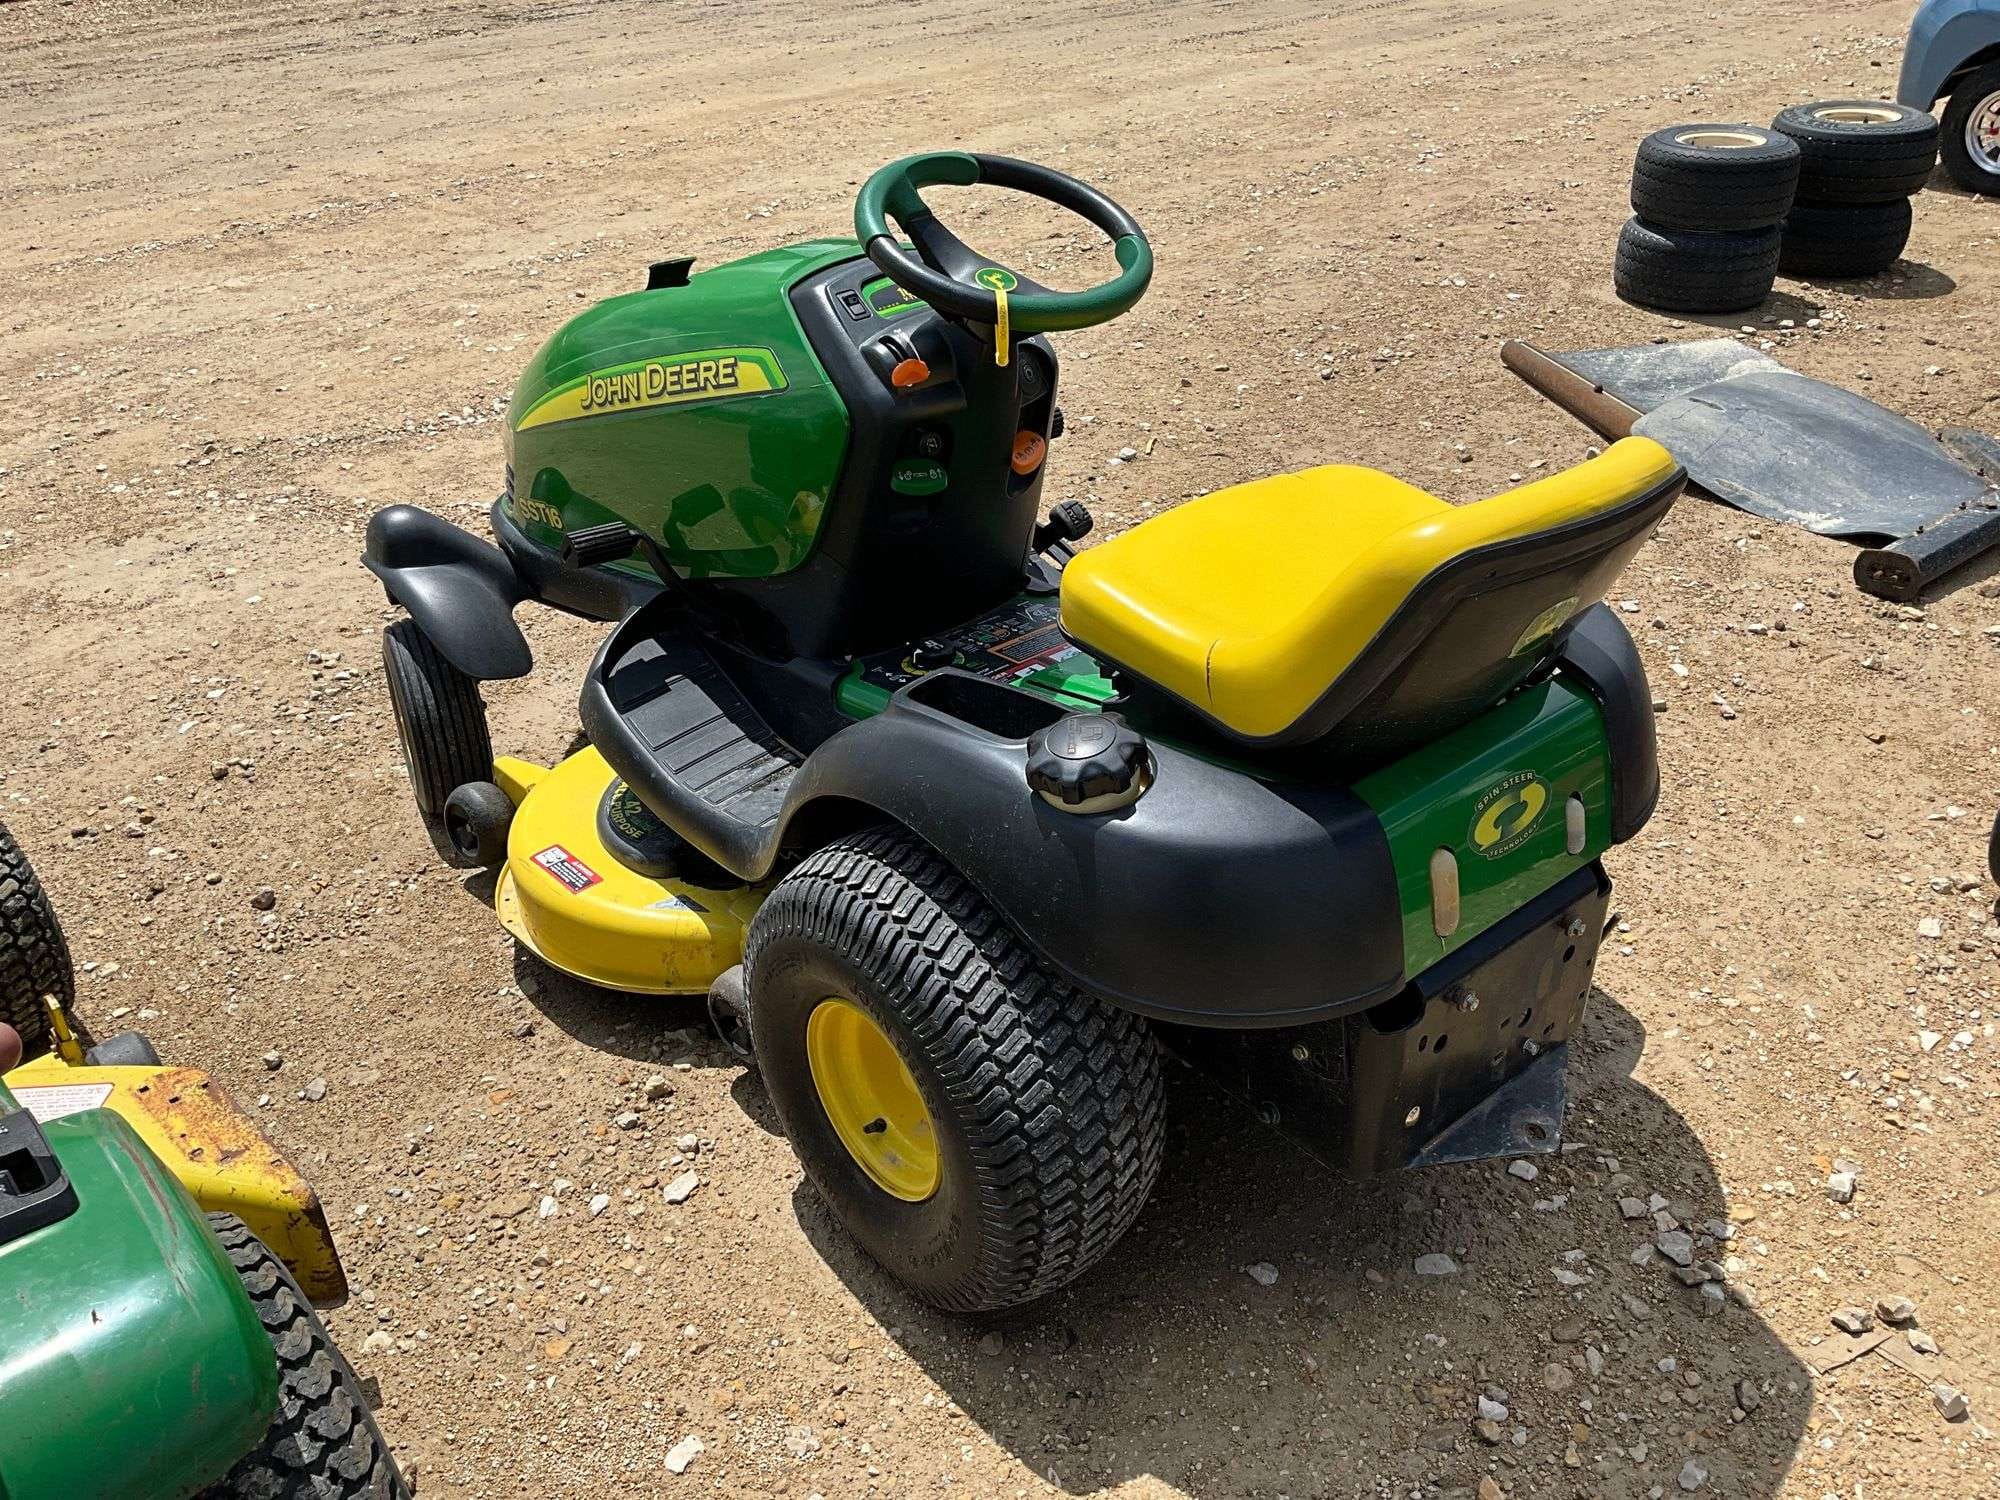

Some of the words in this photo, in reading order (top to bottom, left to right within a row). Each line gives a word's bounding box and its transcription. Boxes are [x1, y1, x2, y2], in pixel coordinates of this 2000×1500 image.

[580, 373, 641, 410] JOHN
[645, 356, 738, 399] DEERE
[1477, 772, 1534, 811] SPIN-STEER
[611, 801, 645, 839] PURPOSE
